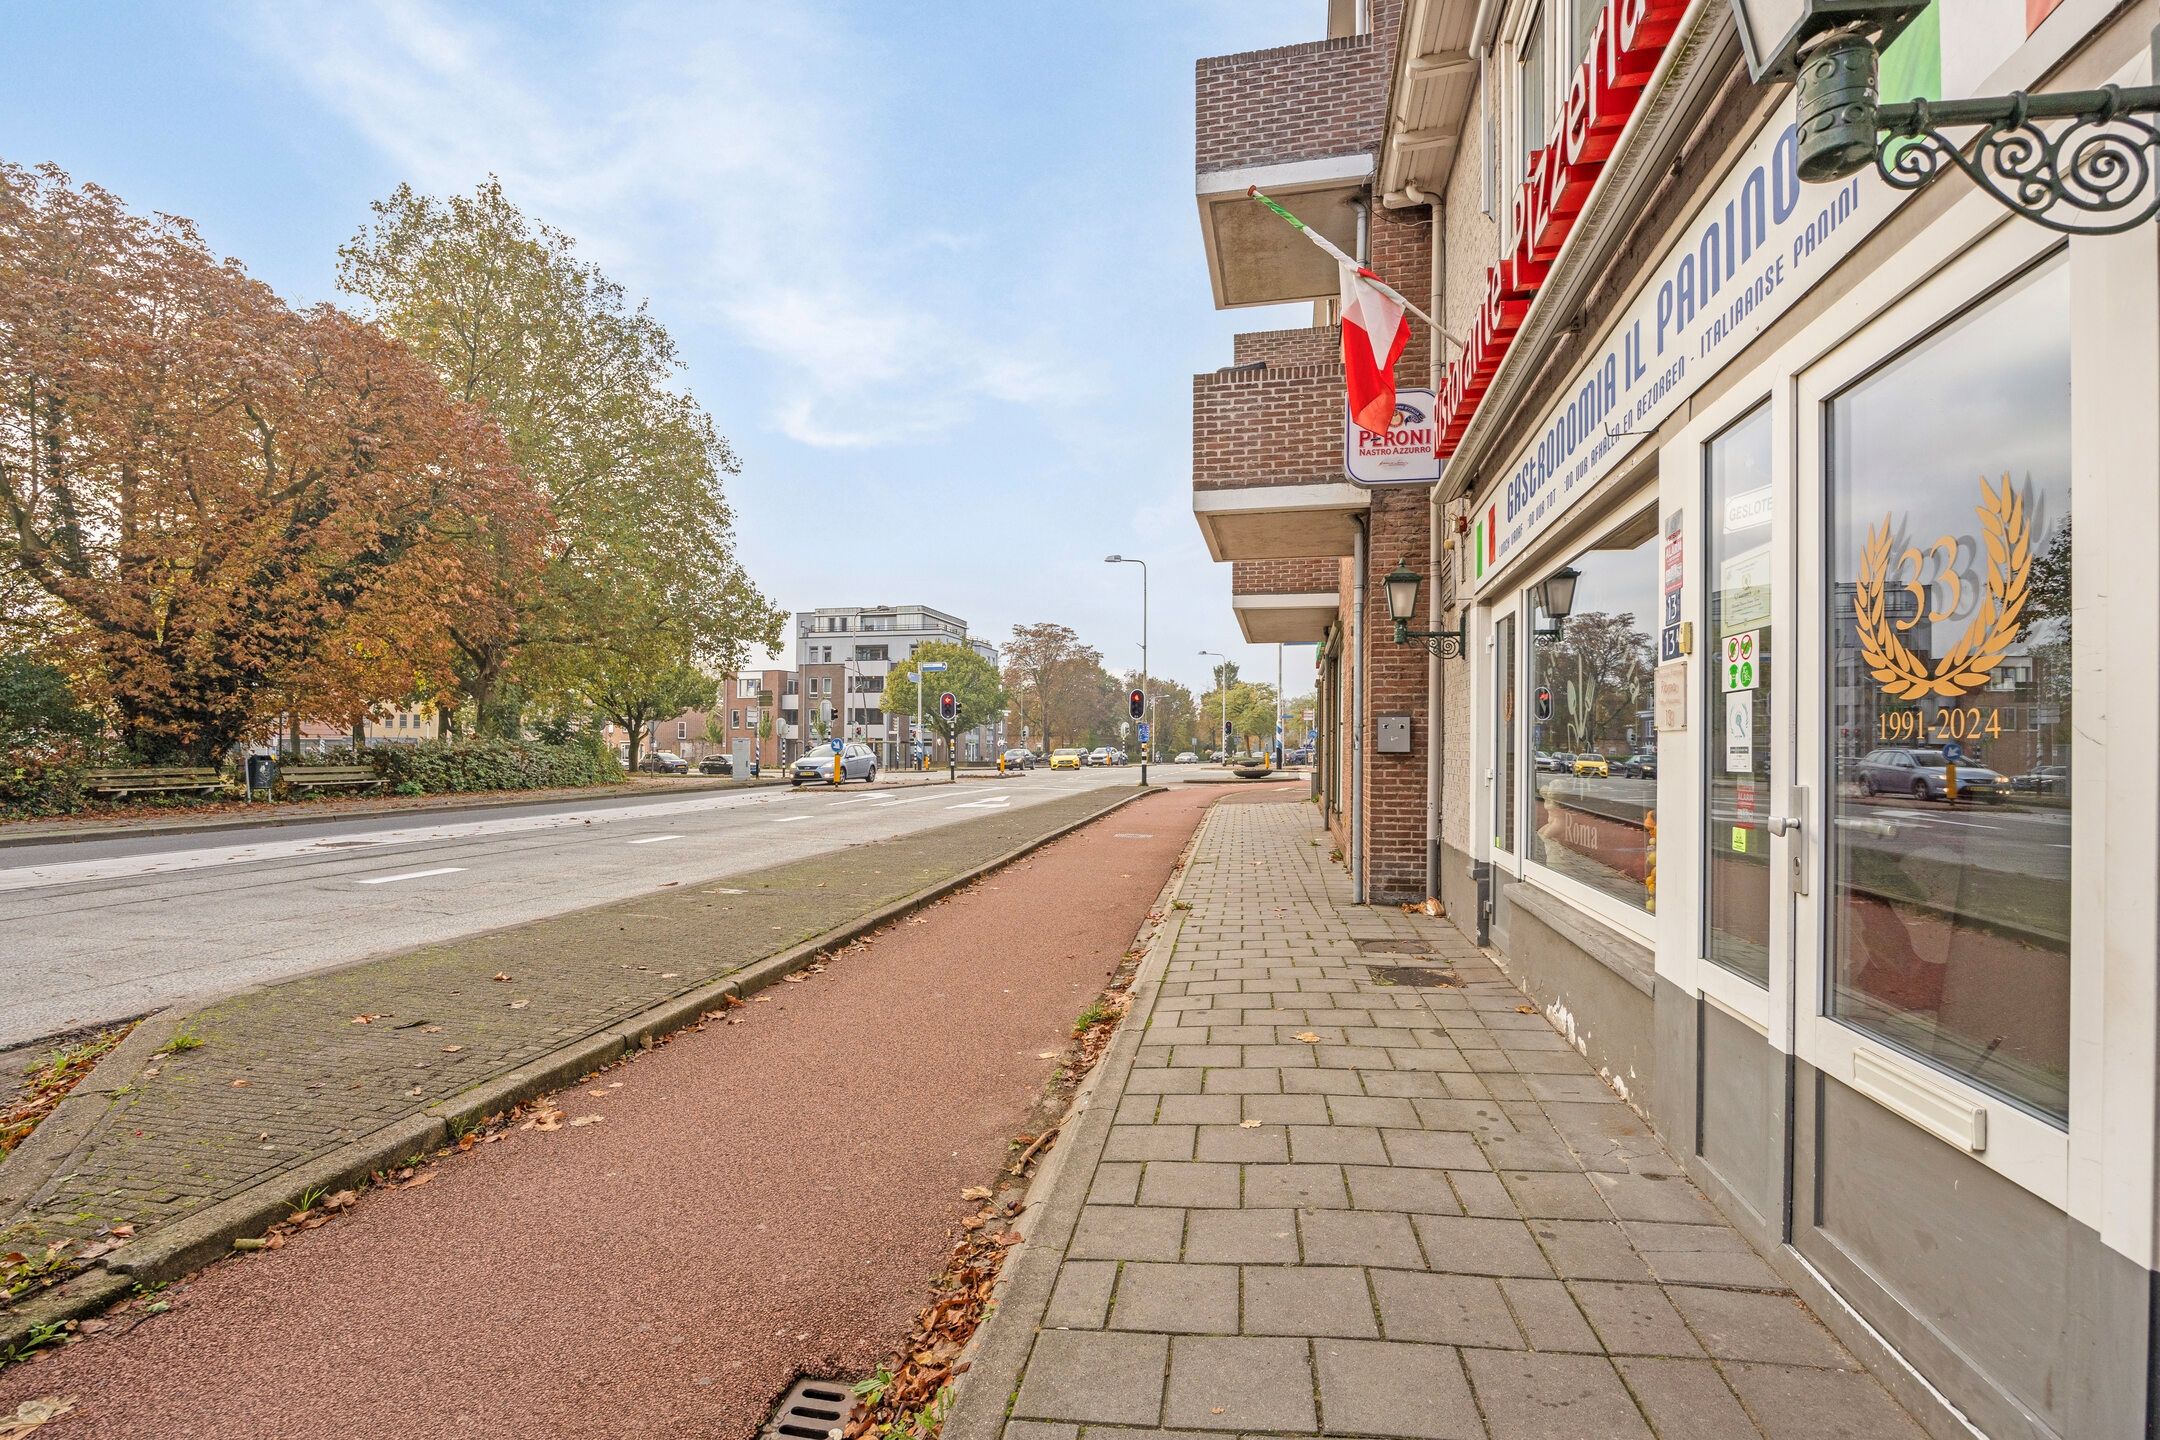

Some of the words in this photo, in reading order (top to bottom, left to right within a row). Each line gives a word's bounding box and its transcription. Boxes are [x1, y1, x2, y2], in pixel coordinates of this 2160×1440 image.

[1625, 319, 1646, 392] IL
[1657, 122, 1800, 357] PANINO
[1433, 260, 1502, 458] Ristorante
[1546, 488, 1556, 509] TOT
[1576, 456, 1588, 482] UUR
[1591, 422, 1620, 468] AFHALEN
[1623, 409, 1633, 433] EN
[1637, 355, 1685, 422] BEZORGEN
[1701, 254, 1784, 358] ITALIAANSE
[1793, 177, 1858, 269] PANINI
[1359, 428, 1431, 447] PERONI
[1359, 448, 1391, 457] NASTRO
[1392, 446, 1431, 455] AZZURRO
[1896, 535, 1959, 631] 33
[1667, 594, 1677, 620] 13
[1879, 707, 2001, 740] 1991-2024
[1565, 812, 1598, 850] Roma
